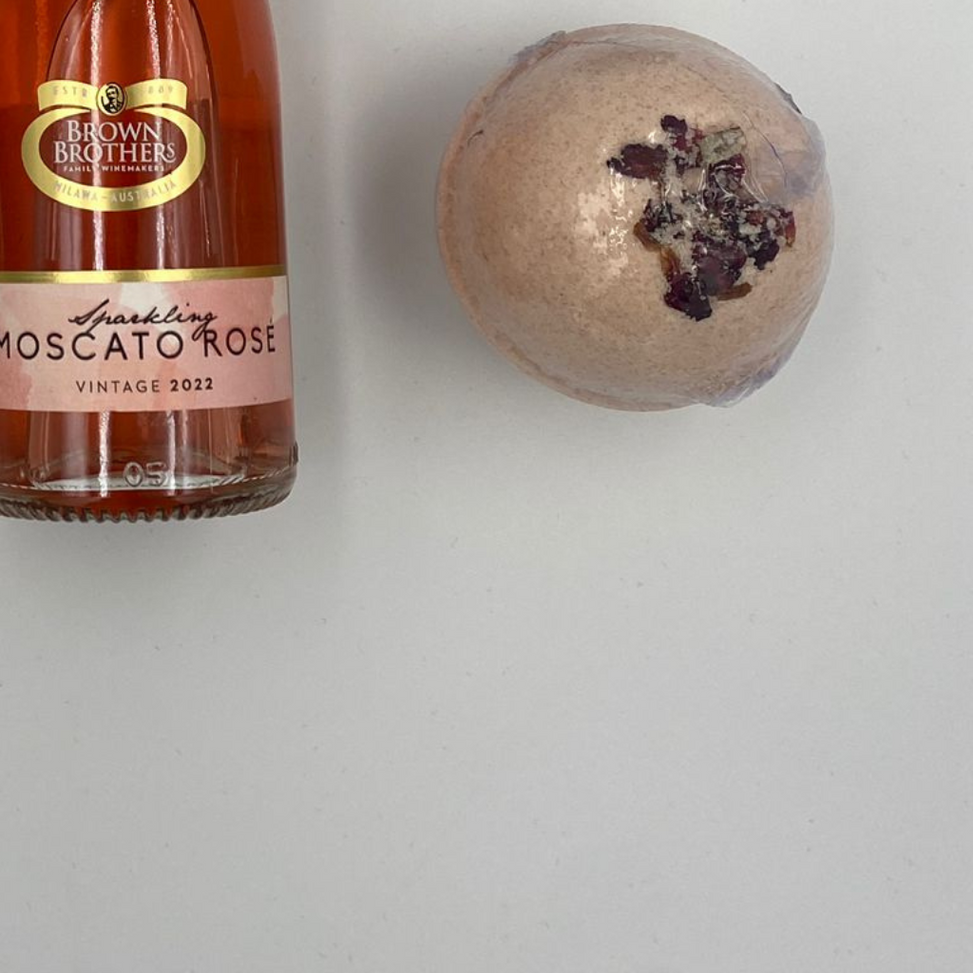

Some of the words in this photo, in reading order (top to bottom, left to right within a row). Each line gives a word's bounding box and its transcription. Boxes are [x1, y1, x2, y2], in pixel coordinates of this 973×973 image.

[66, 120, 162, 143] BROWN
[53, 142, 177, 164] BROTHERS
[68, 299, 218, 341] Sparkling
[203, 317, 276, 358] ROSÉ
[76, 379, 161, 394] VINTAGE
[170, 377, 214, 393] 2022
